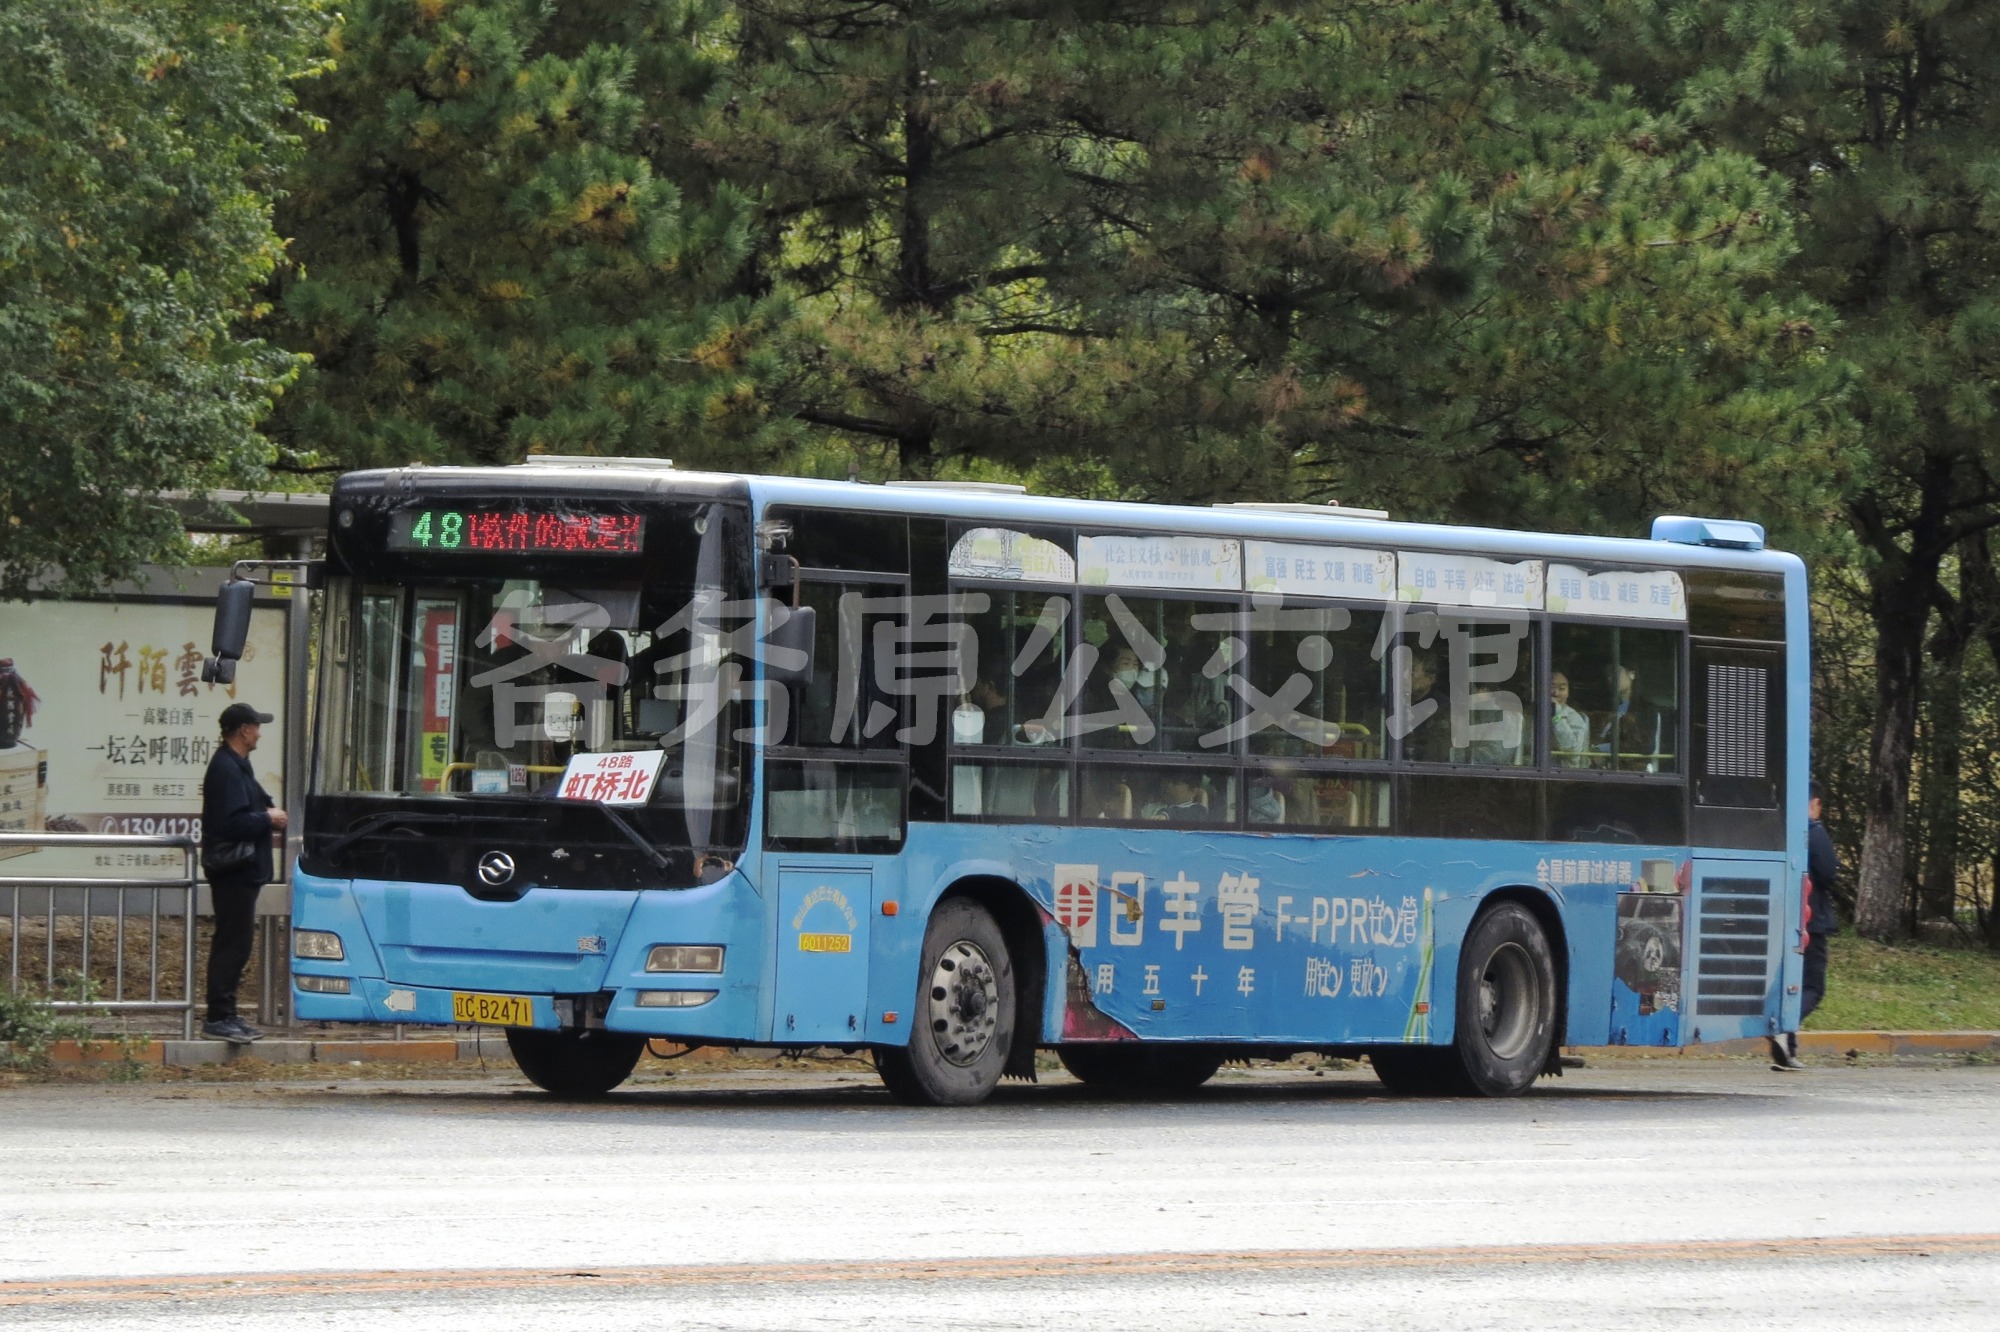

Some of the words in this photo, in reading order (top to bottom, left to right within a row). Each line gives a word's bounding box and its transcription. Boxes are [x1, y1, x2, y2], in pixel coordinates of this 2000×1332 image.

[411, 511, 464, 548] 48
[1265, 557, 1288, 579] 富强
[1294, 558, 1316, 581] 民主
[1324, 560, 1345, 582] 文明
[1352, 562, 1374, 584] 和谐
[1414, 567, 1436, 588] 自由
[1444, 569, 1466, 590] 平等
[1474, 570, 1496, 592] 公正
[1503, 572, 1525, 594] 法治
[1559, 578, 1582, 599] 爱国
[1588, 580, 1610, 601] 敬业
[1617, 582, 1639, 603] 诚信
[1649, 584, 1671, 605] 友善
[143, 707, 194, 725] 高粱白酒
[86, 735, 222, 765] 一坛会呼吸的
[597, 755, 634, 769] 48路
[564, 769, 650, 801] 虹桥北
[1536, 858, 1633, 885] 全屋前置过滤器
[1110, 871, 1260, 951] 日丰管
